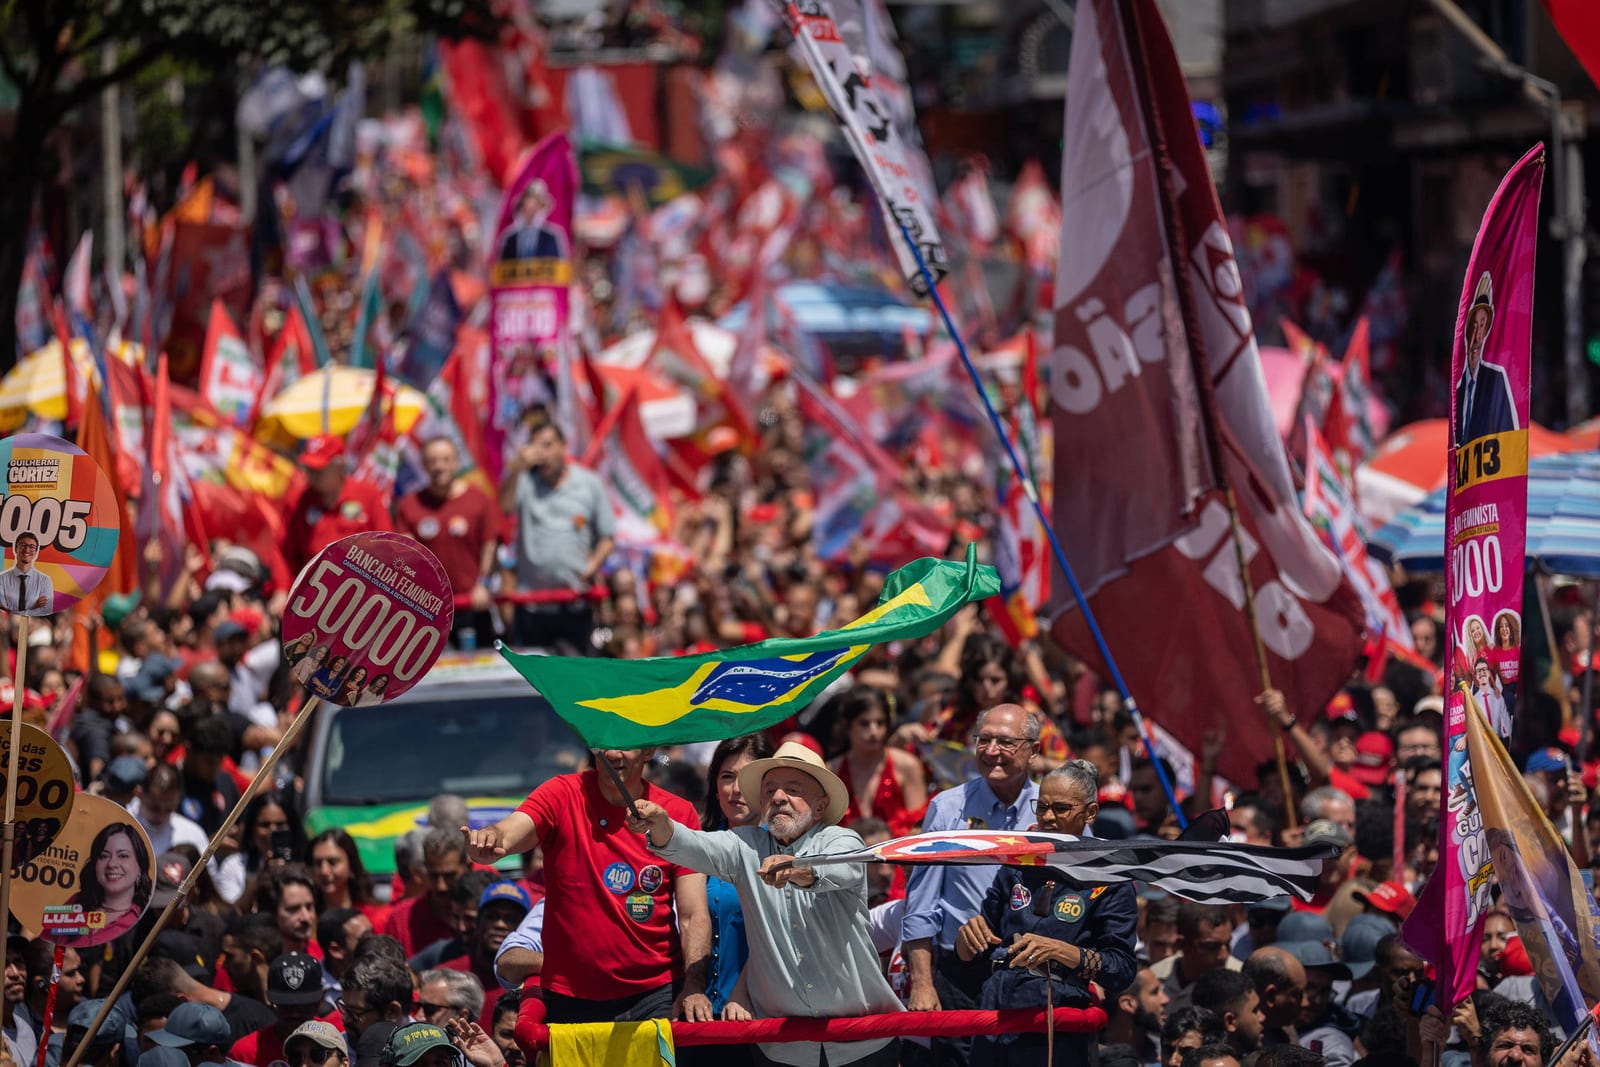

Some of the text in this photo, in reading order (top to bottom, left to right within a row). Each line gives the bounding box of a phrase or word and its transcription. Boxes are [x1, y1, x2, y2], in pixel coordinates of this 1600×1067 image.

[10, 459, 59, 467] GUILHERME
[1455, 438, 1501, 490] LA 13
[9, 466, 58, 482] CORTEZ
[0, 494, 91, 549] 005
[345, 544, 399, 587] BANCADA
[1451, 535, 1503, 607] 000
[291, 559, 441, 681] 50000
[22, 743, 46, 755] das
[1, 751, 43, 772] tas
[43, 913, 102, 924] LULA 13
[1058, 901, 1081, 917] 180
